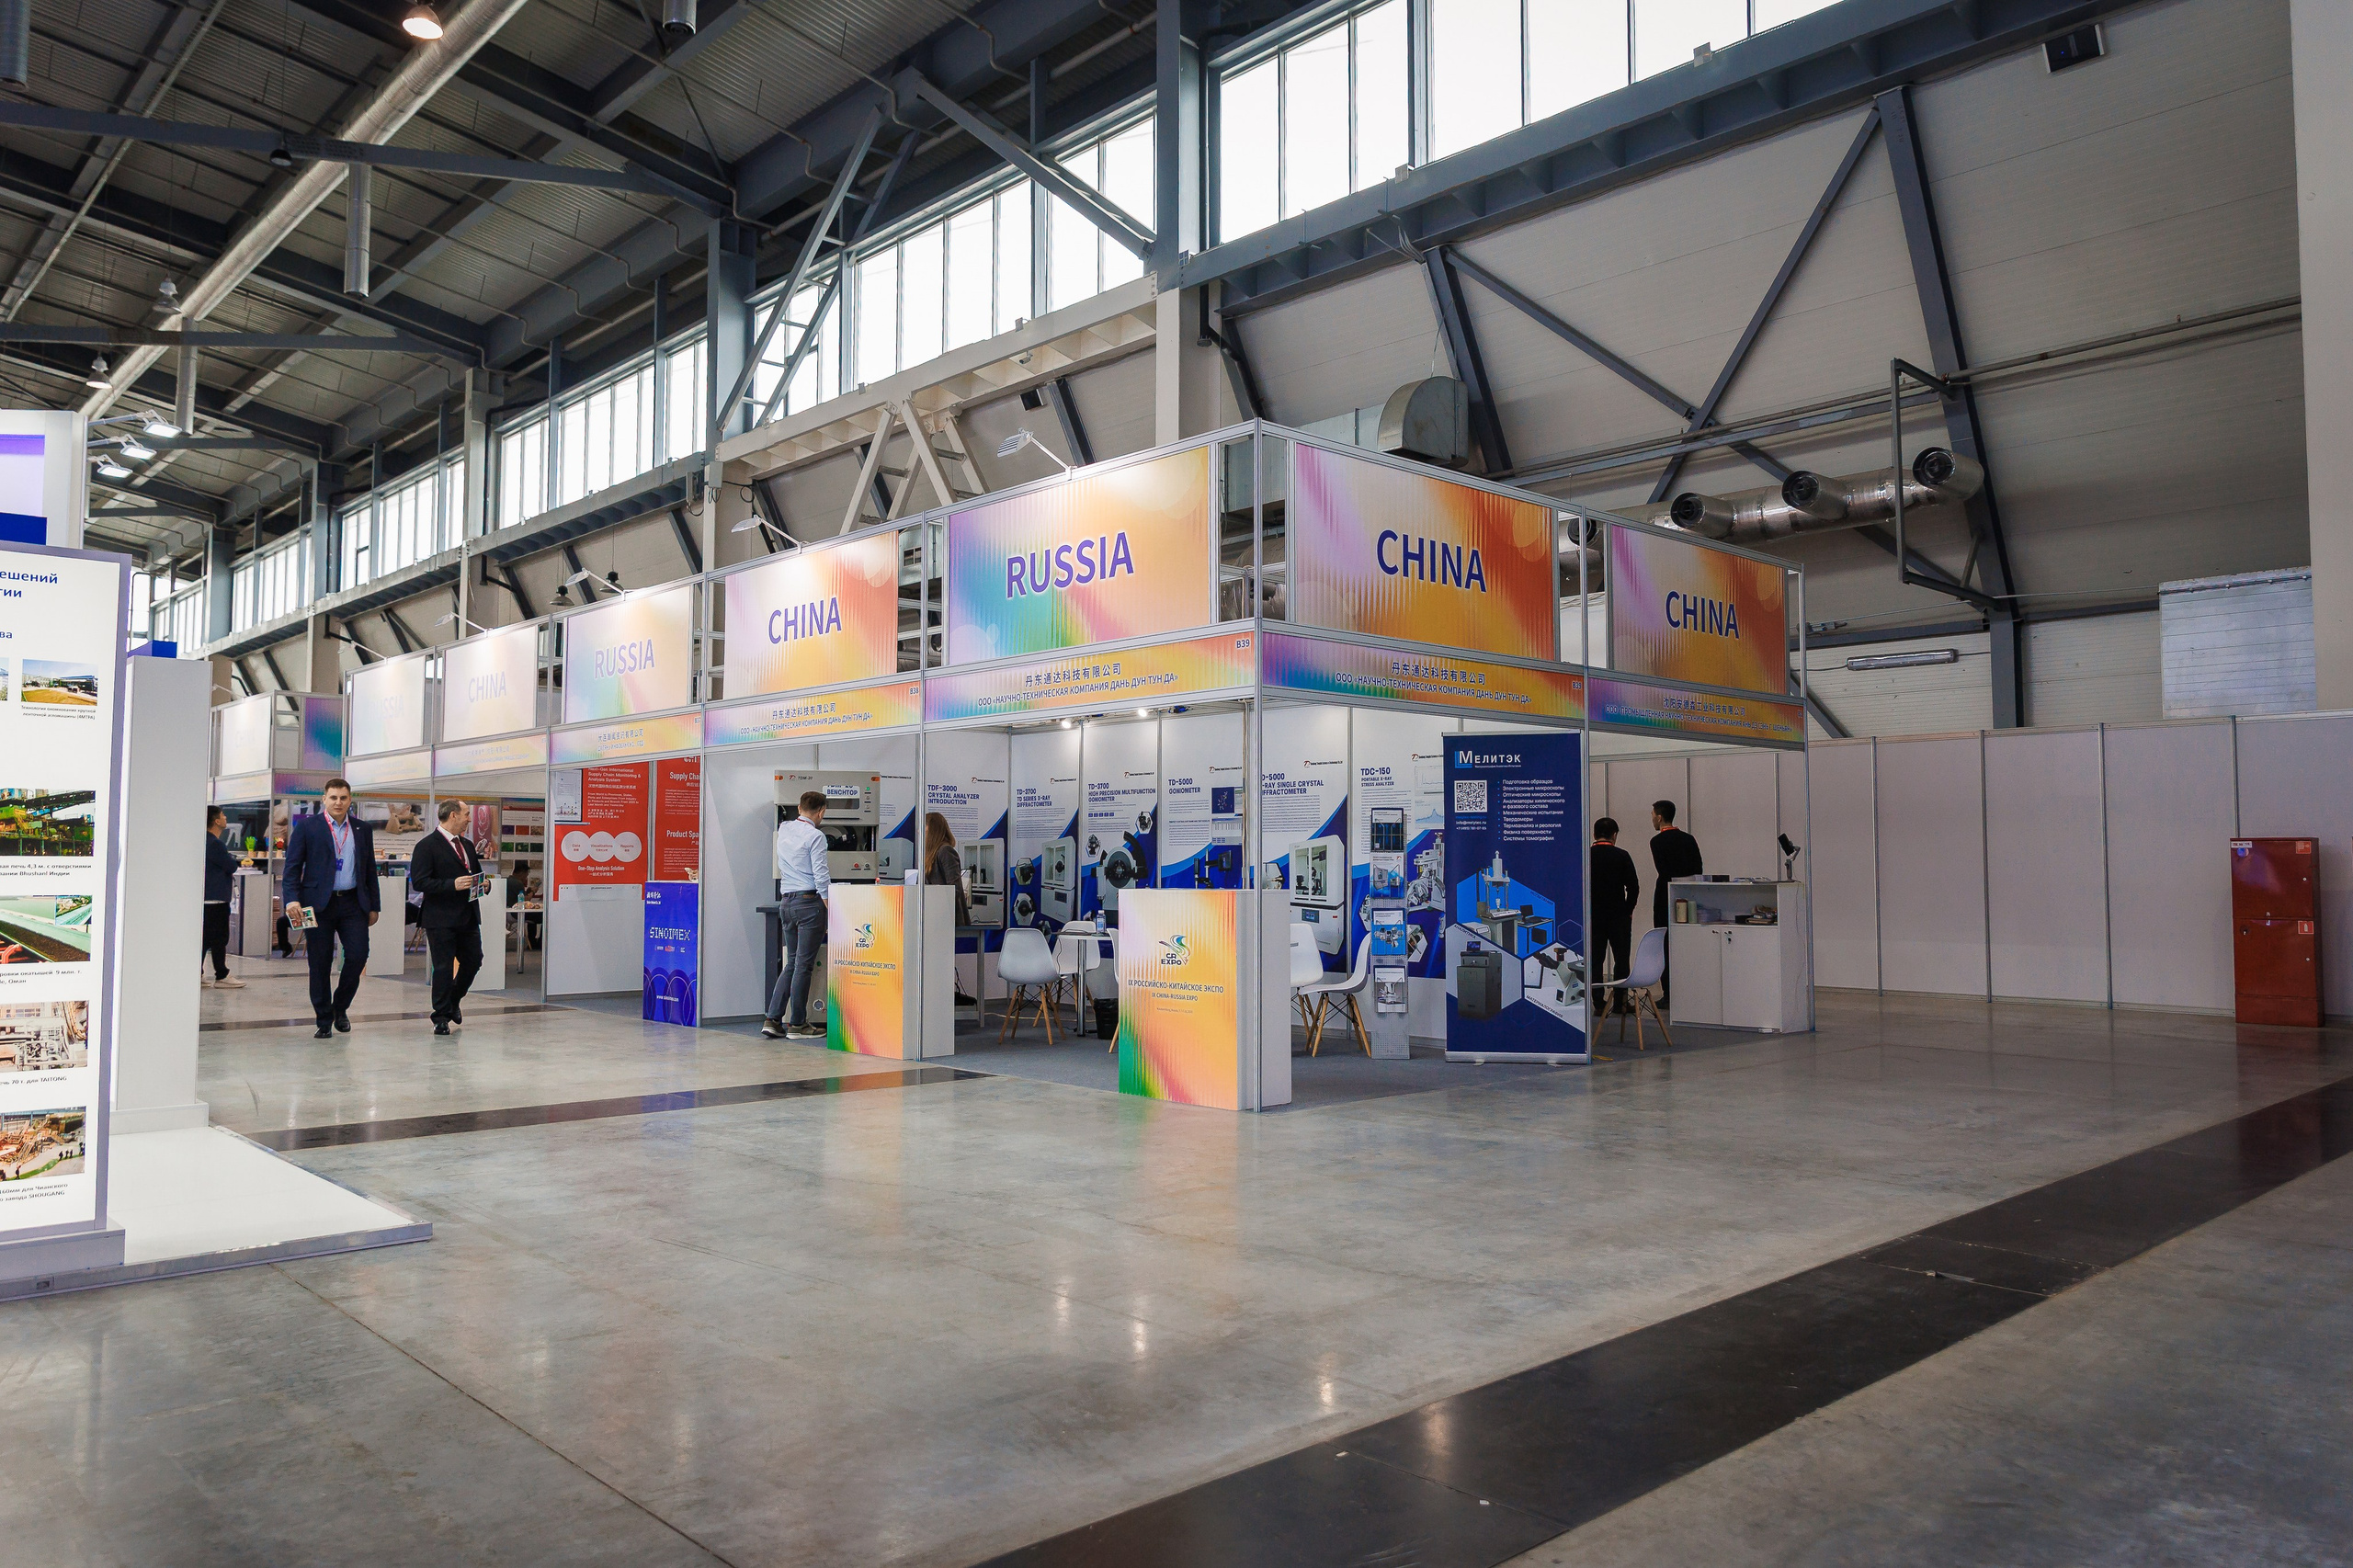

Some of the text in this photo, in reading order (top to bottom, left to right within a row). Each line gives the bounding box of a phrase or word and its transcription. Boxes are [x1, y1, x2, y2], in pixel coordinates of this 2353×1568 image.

[1006, 531, 1134, 599] RUSSIA
[1377, 528, 1487, 593] CHINA
[767, 596, 843, 644] CHINA
[1665, 590, 1740, 639] CHINA
[595, 639, 655, 679] RUSSIA
[1025, 663, 1121, 687] 丹东通达科技有限公司
[1392, 662, 1485, 686] 丹东通达科技有限公司
[468, 671, 506, 703] CHINA
[978, 698, 992, 707] ООО
[1069, 681, 1109, 695] КОМПАНИЯ
[1110, 680, 1130, 691] ДАНЬ
[1131, 676, 1146, 688] ДУН
[1148, 675, 1163, 685] ТУН
[1336, 672, 1353, 683] ООО
[1438, 685, 1475, 698] КОМПАНИЯ
[1476, 689, 1493, 699] ДАНЬ
[1495, 691, 1506, 701] ДУН
[1508, 693, 1519, 702] ТУН
[772, 702, 836, 721] 丹东通达科技有限公司
[669, 771, 688, 781] Supply
[1298, 779, 1324, 788] CRYSTAL
[1360, 767, 1391, 776] TDC-150
[927, 784, 958, 792] TDF-3000
[1168, 787, 1201, 795] GONIOMETER
[666, 829, 688, 838] Product
[649, 926, 691, 942] SINOIMEX
[1133, 979, 1202, 992] РОССИЙСКО-КИТАЙСКОЕ
[1203, 984, 1223, 994] ЭКСПО
